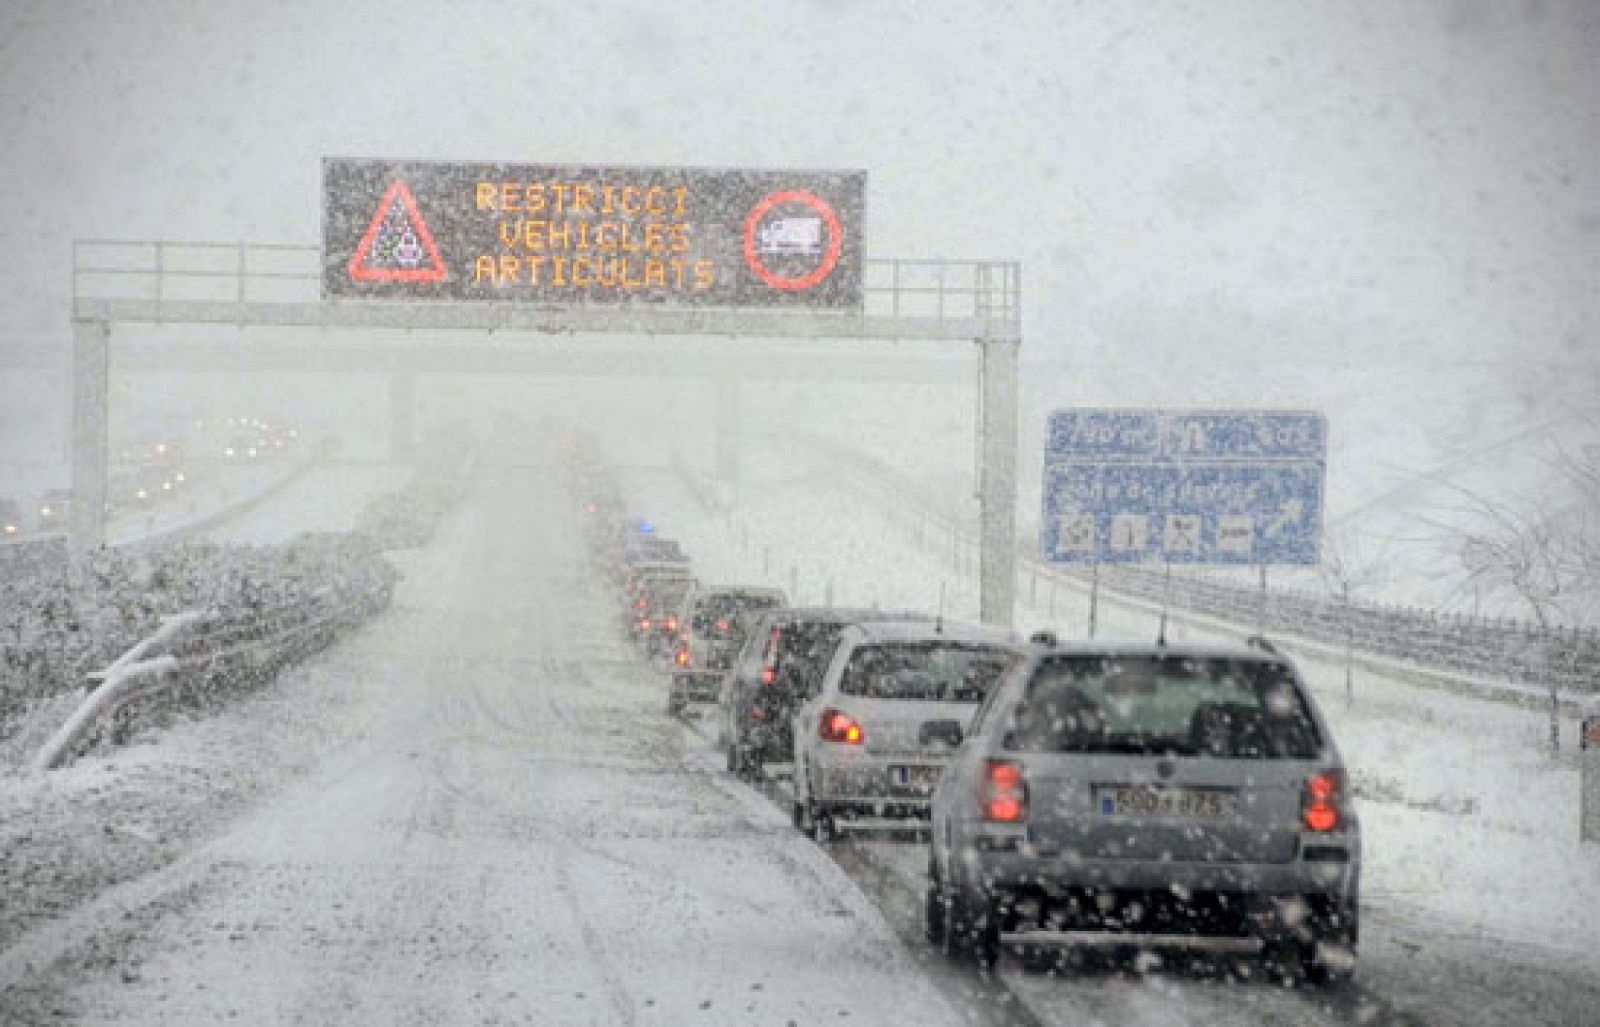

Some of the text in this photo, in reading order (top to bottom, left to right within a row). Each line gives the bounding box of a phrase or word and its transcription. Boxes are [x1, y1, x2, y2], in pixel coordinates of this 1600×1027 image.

[476, 182, 687, 215] RESTRICCI
[499, 220, 691, 252] VEHICLES
[475, 255, 715, 288] ARTICULATS
